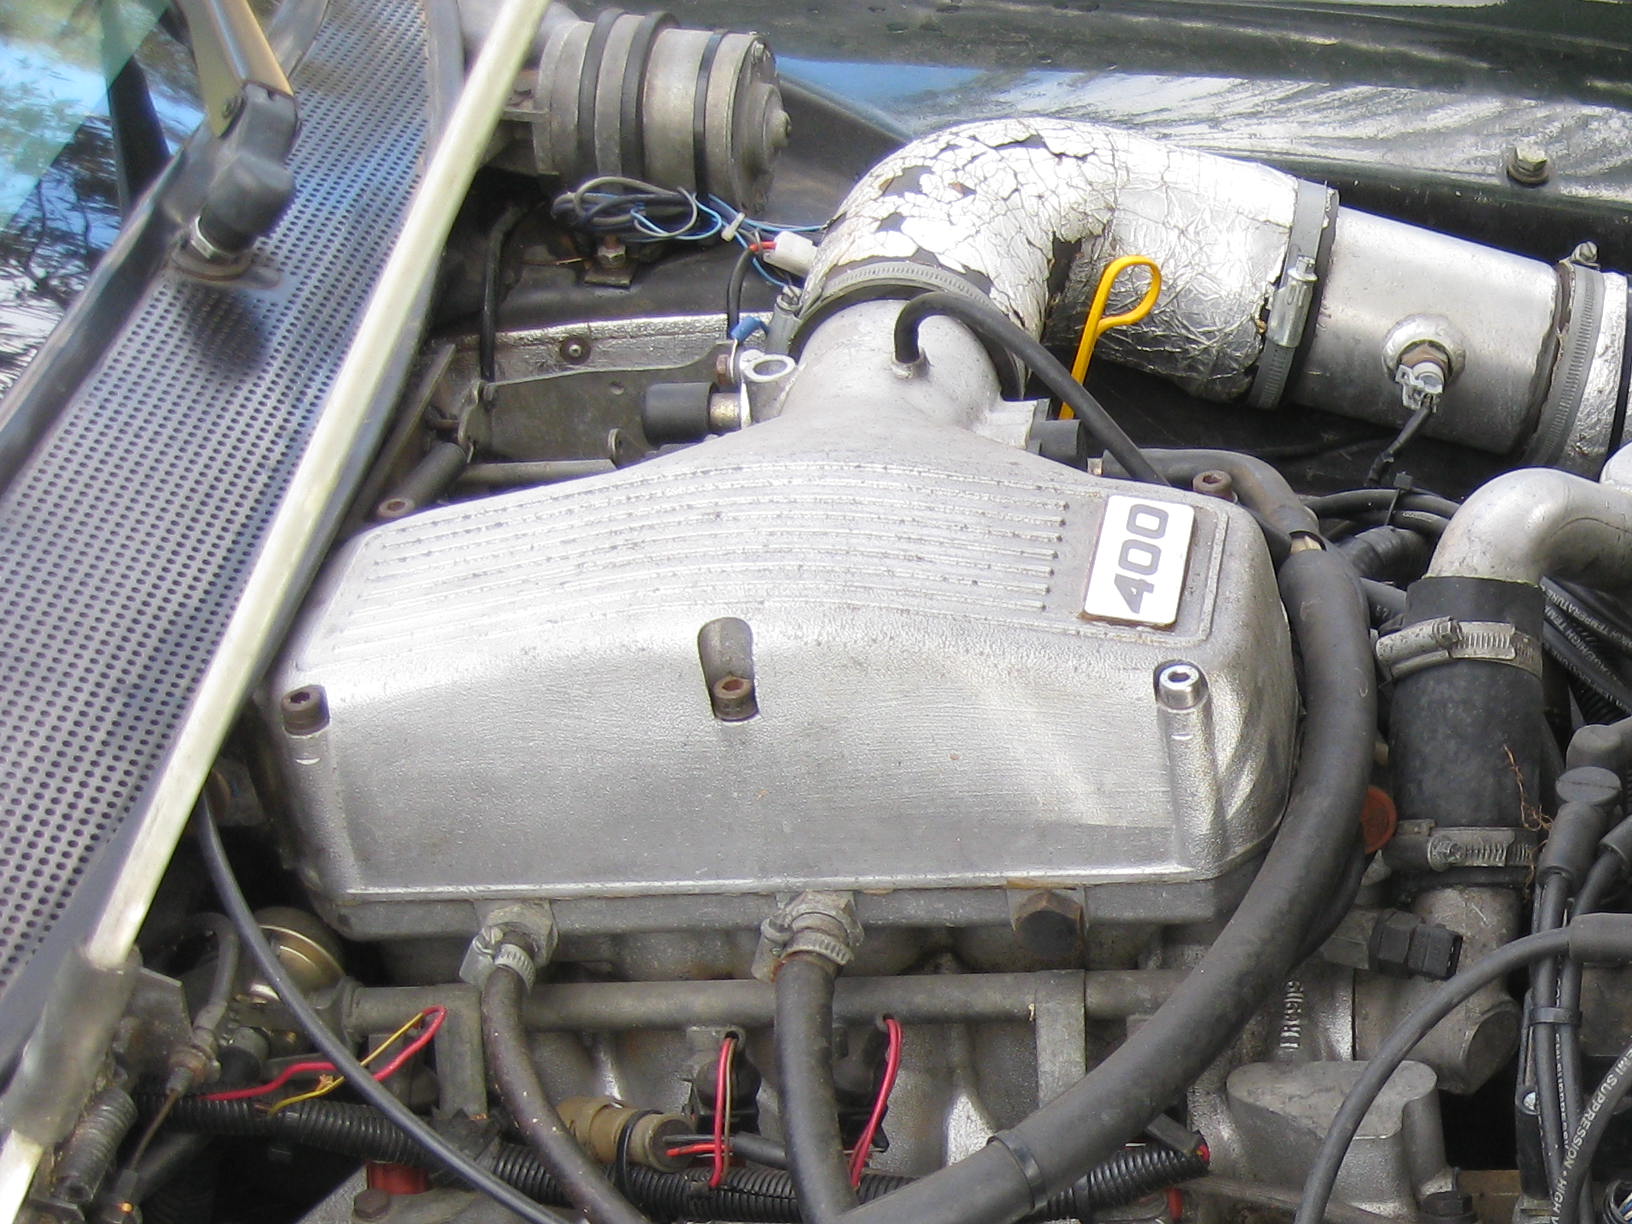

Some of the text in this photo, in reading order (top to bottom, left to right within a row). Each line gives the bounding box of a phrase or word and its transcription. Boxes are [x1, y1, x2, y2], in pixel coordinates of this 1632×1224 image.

[1114, 503, 1169, 614] 400
[1563, 1073, 1618, 1169] SUPPRESSION
[1552, 1176, 1567, 1212] HIGH
